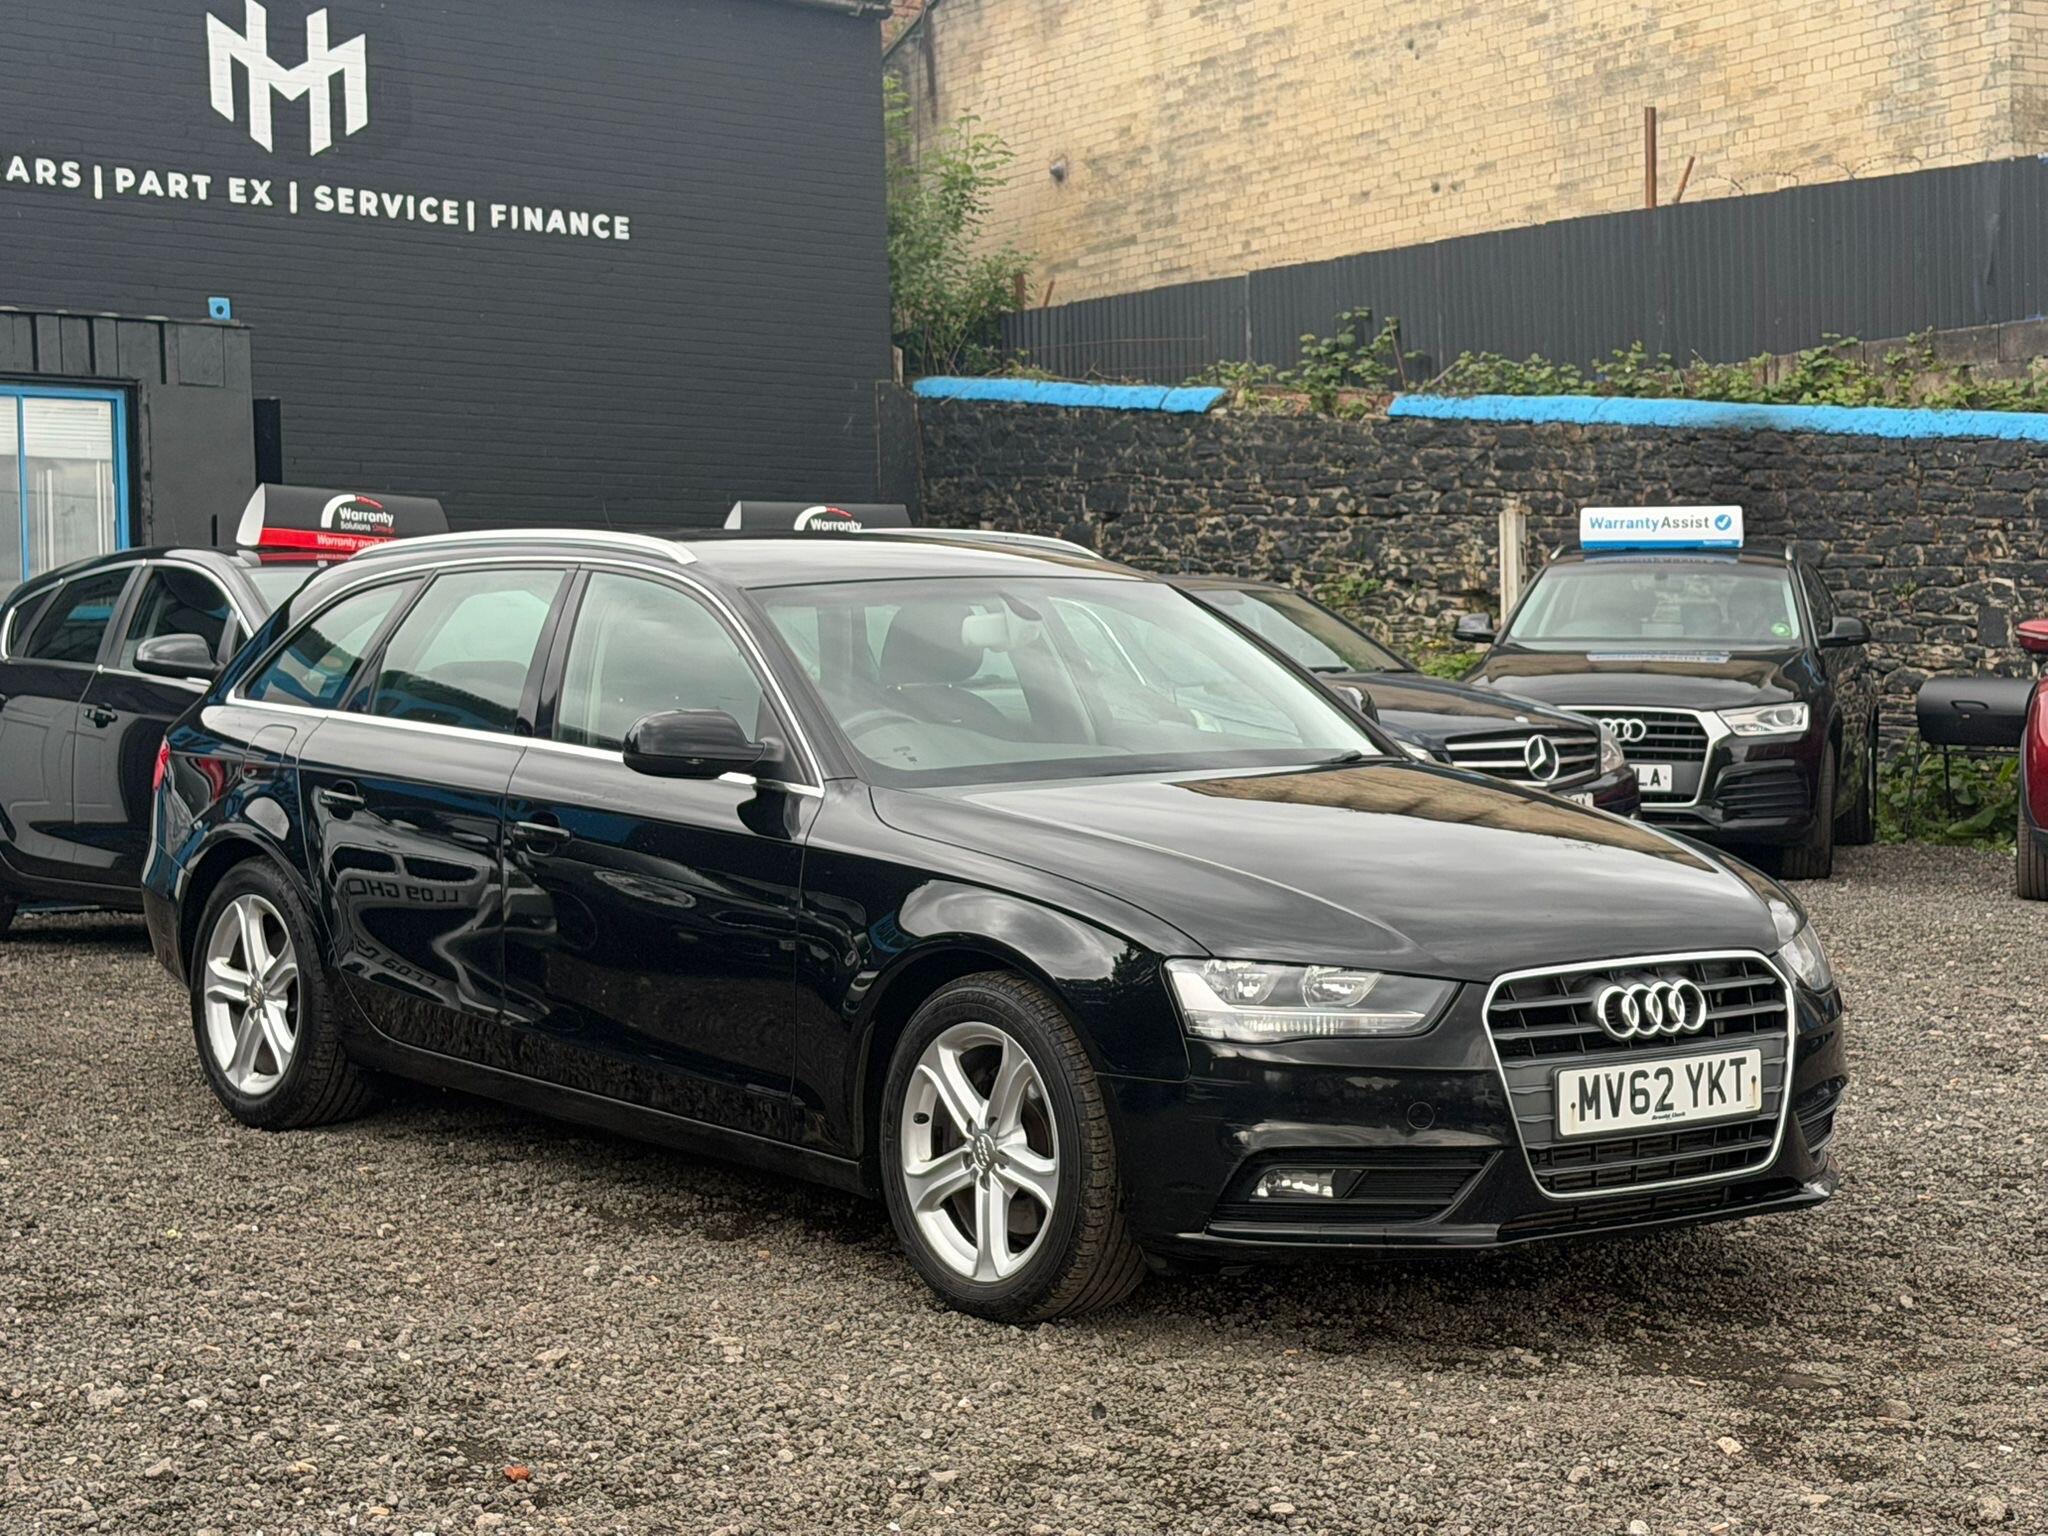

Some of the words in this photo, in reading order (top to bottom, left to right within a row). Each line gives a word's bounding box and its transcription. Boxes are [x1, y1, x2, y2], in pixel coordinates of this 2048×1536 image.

[114, 167, 212, 201] PART
[228, 176, 273, 207] EX
[313, 184, 459, 226] SERVICE
[490, 203, 630, 240] FINANCE
[338, 506, 394, 527] Warranty
[340, 521, 371, 532] Solutions
[810, 517, 862, 531] Warranty
[1578, 1067, 1674, 1122] MV62
[1685, 1057, 1747, 1108] YKT
